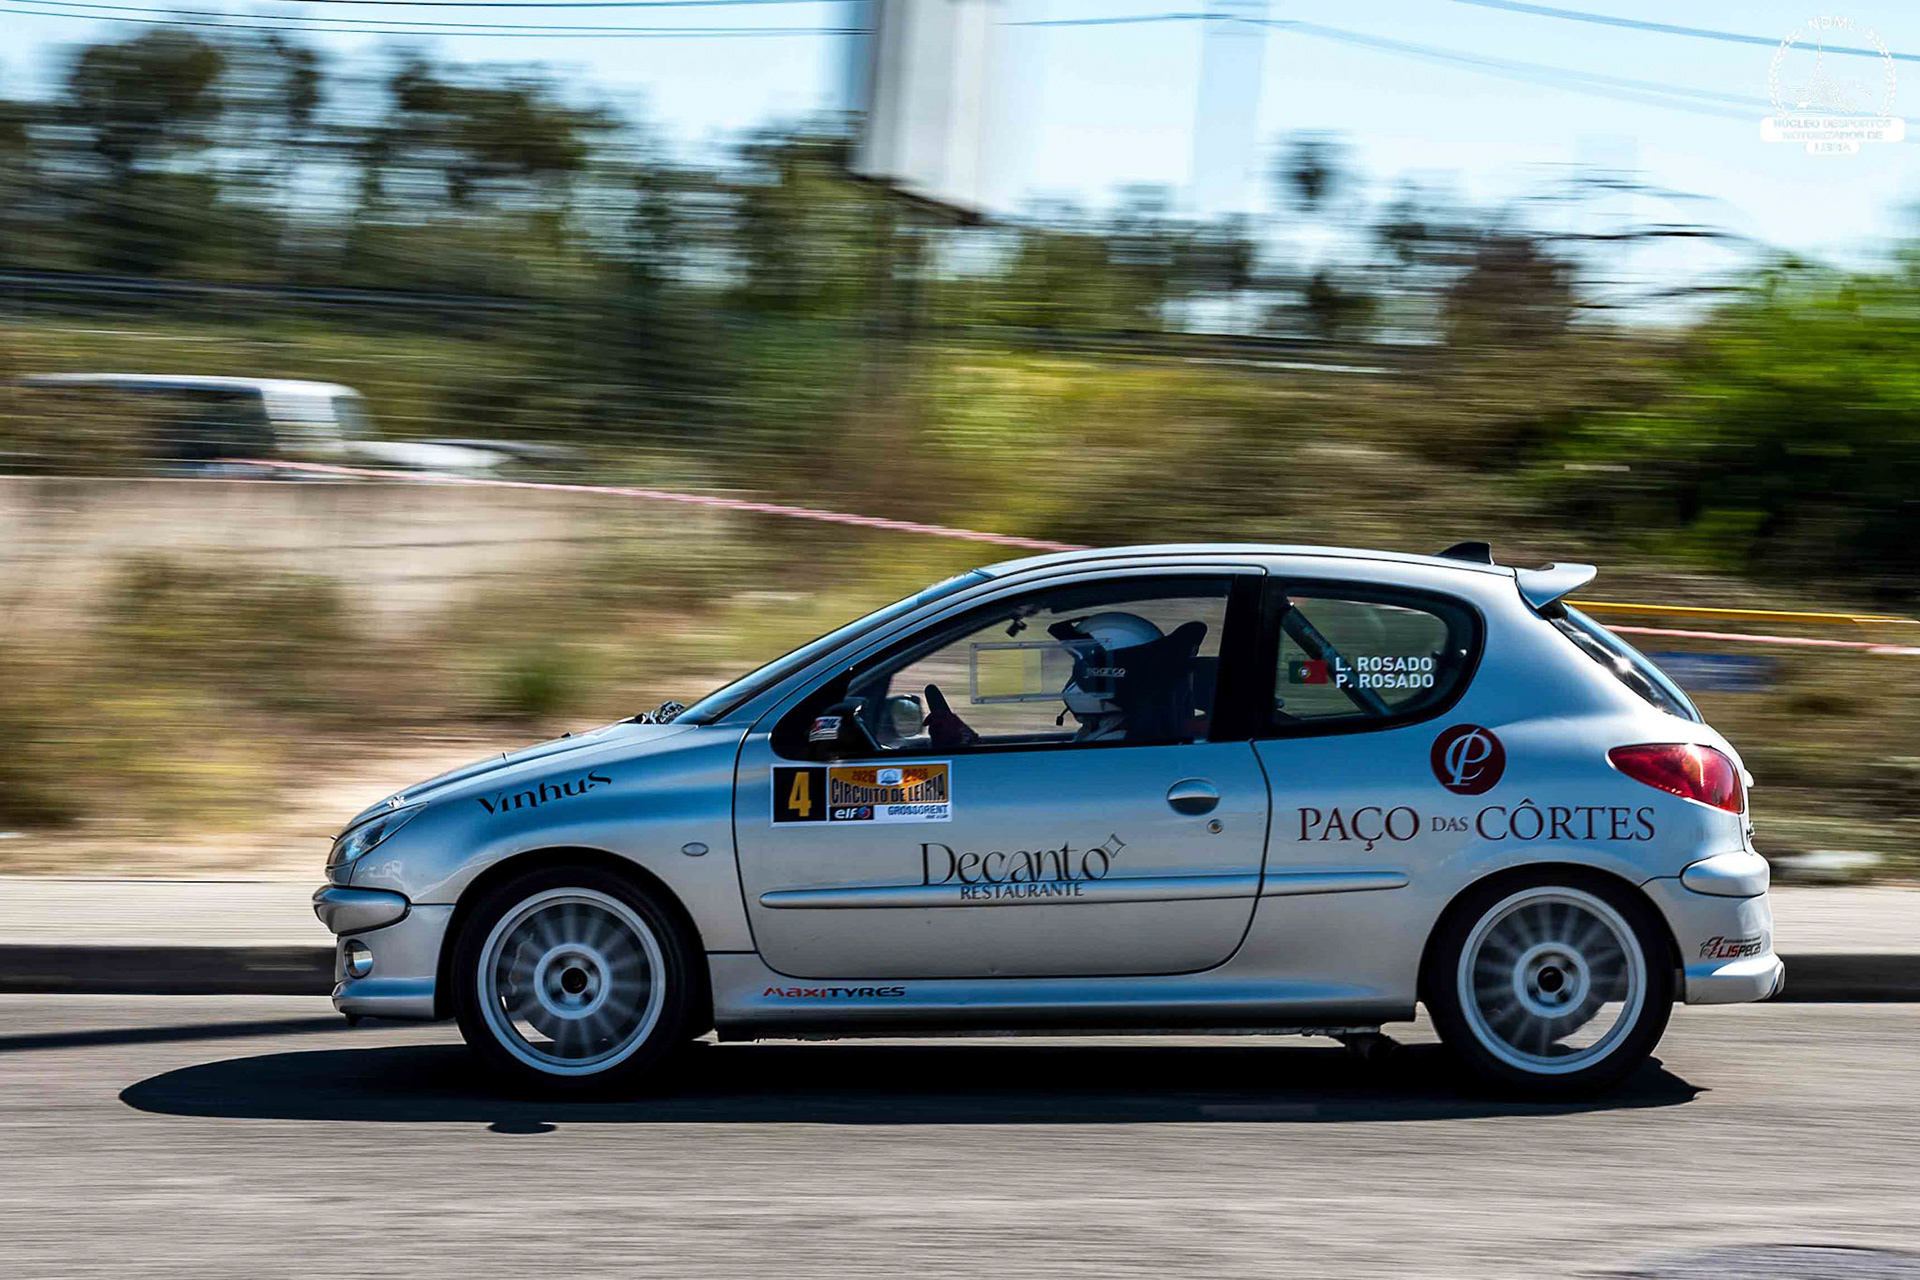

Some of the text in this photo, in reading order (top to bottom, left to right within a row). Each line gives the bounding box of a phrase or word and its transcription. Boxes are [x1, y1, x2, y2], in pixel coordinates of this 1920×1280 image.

[1335, 656, 1433, 672] L. ROSADO
[1336, 673, 1435, 689] P. ROSADO
[788, 771, 812, 817] 4
[831, 772, 945, 804] CIRCUITO DE LEIRIA
[834, 806, 858, 819] elf
[1297, 797, 1655, 851] PAÇO DAS CÔRTES
[919, 840, 1109, 886] Decanto
[960, 881, 1085, 900] RESTAURANTE
